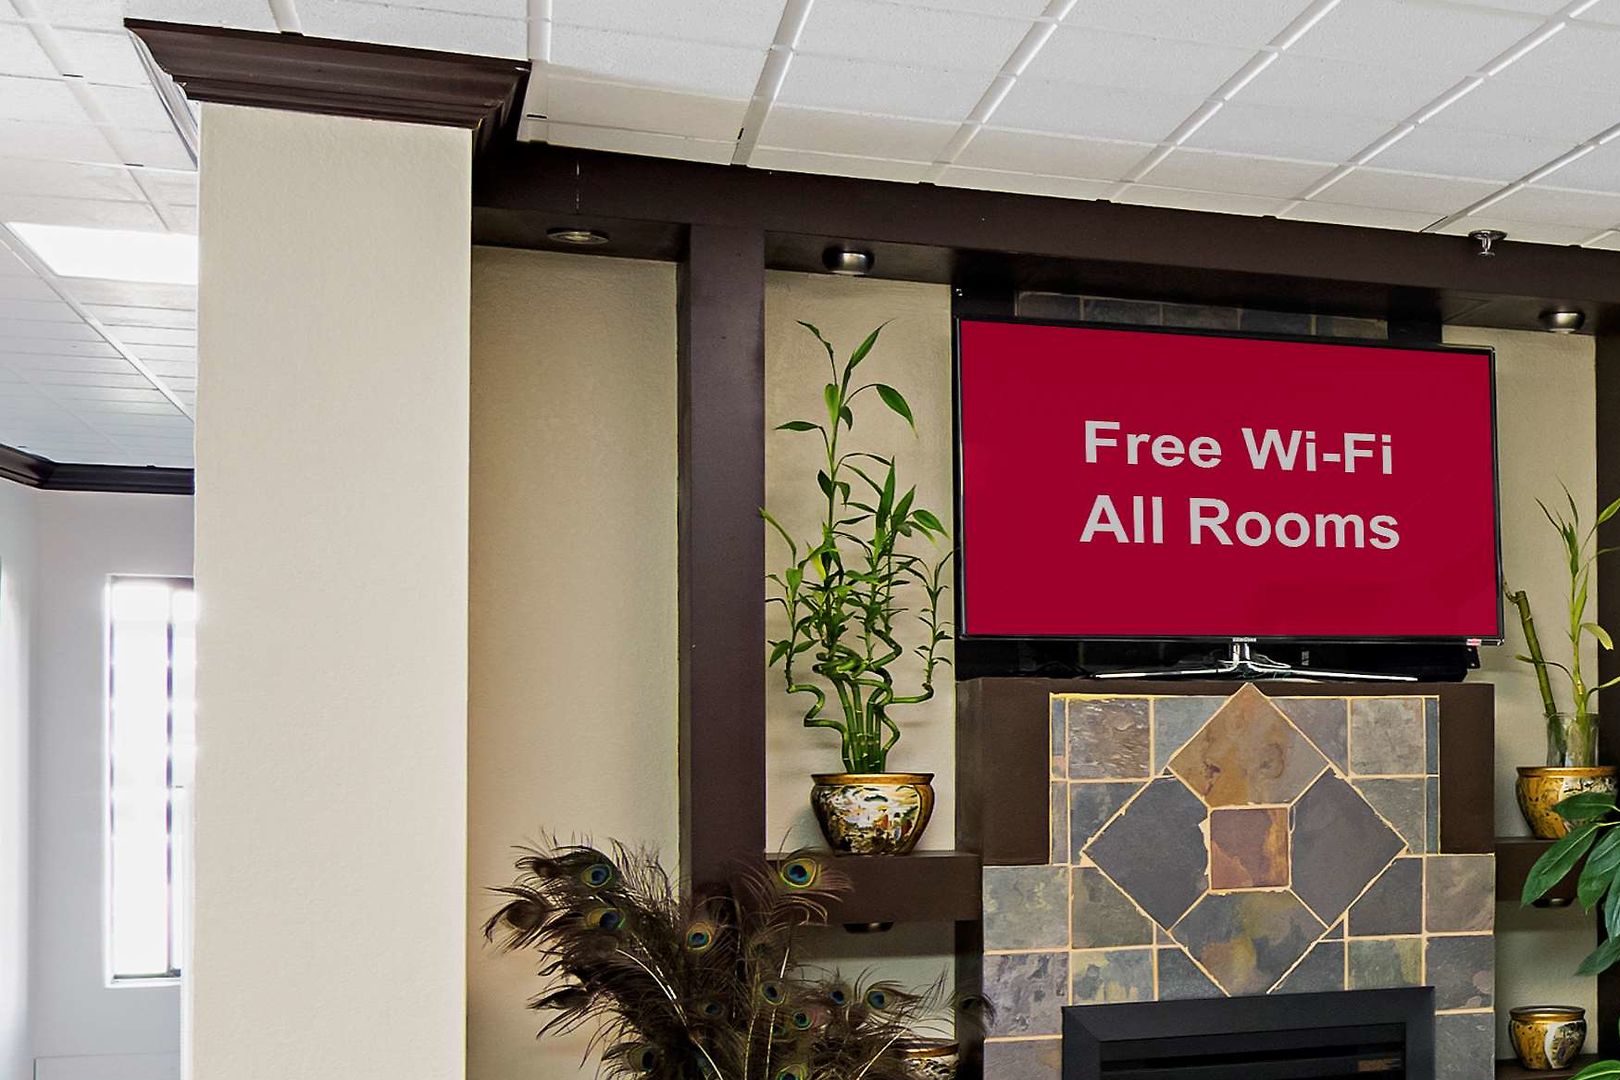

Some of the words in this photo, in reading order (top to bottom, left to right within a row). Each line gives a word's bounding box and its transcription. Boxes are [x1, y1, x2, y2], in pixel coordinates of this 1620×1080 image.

[1084, 420, 1222, 469] Free
[1241, 427, 1393, 475] Wi-Fi
[1079, 494, 1164, 544] All
[1189, 497, 1400, 550] Rooms
